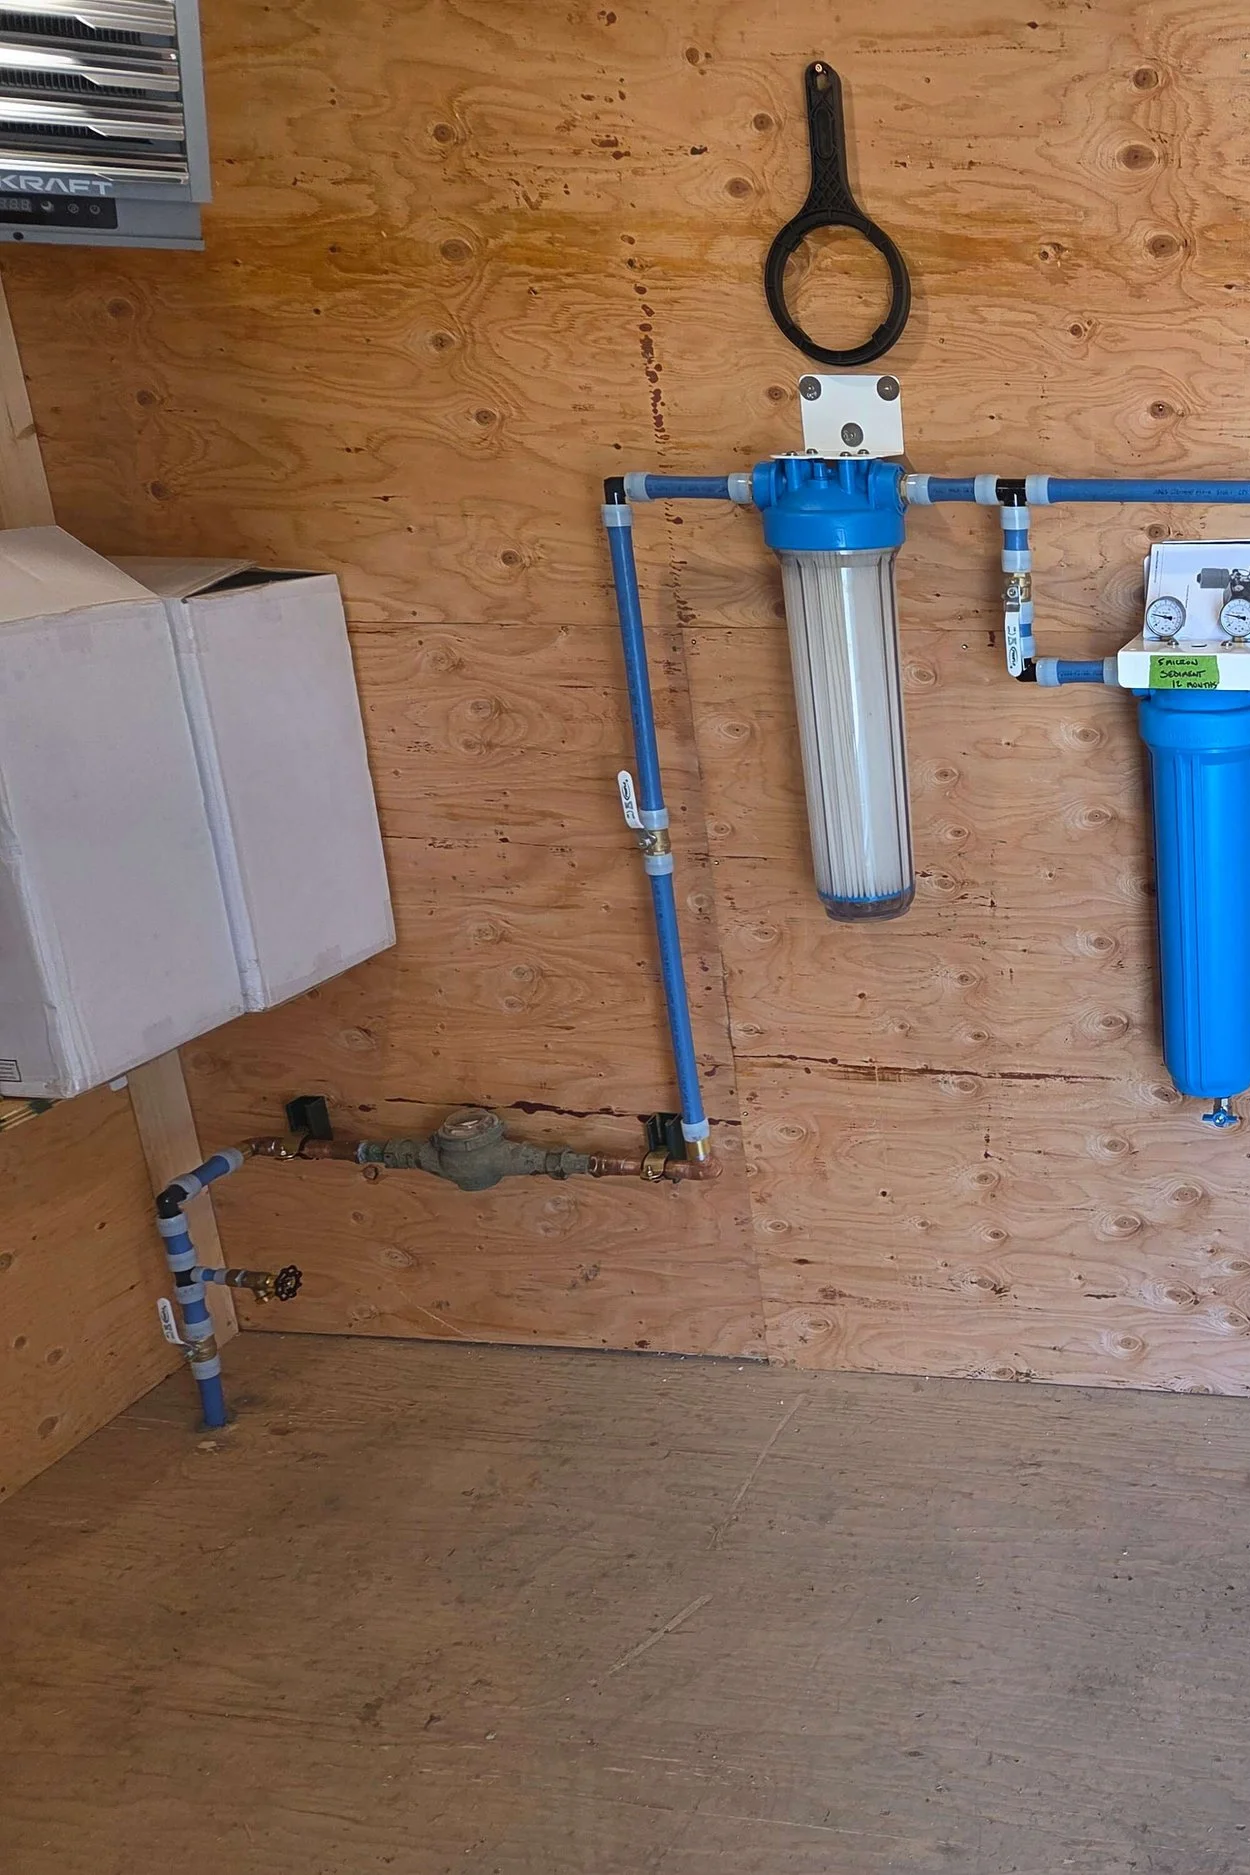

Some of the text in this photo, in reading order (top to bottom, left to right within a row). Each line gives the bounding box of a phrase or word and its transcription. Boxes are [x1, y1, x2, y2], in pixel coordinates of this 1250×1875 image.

[0, 174, 113, 195] KRAFT
[1160, 670, 1206, 678] SEDIMENT
[1172, 680, 1218, 689] 12 MONTHS
